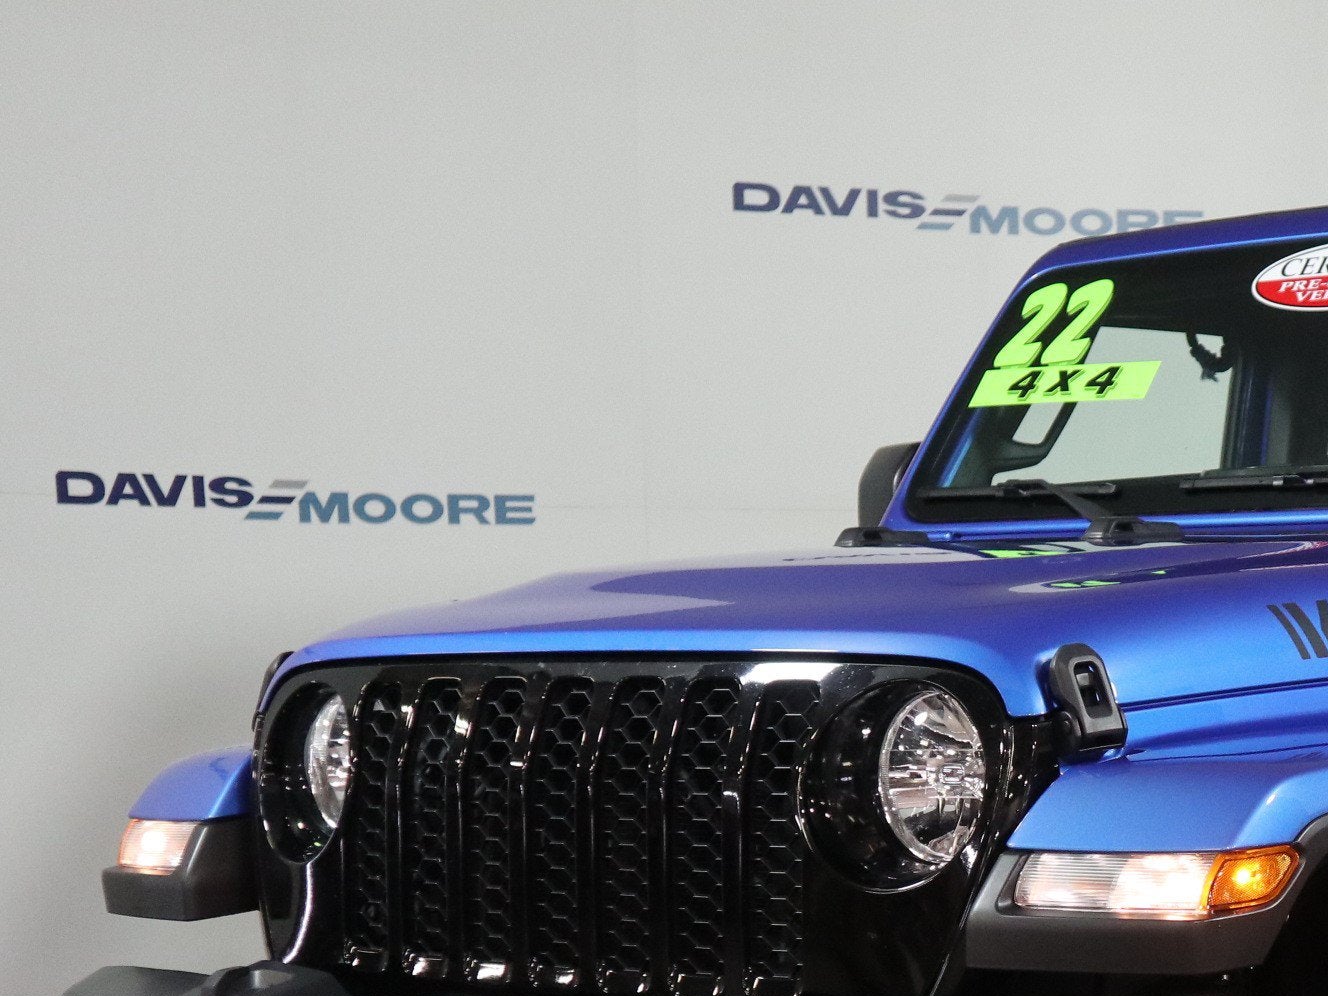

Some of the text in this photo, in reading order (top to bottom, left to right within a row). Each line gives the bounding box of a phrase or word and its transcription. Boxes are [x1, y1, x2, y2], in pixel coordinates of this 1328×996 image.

[732, 181, 927, 220] DAVIS
[993, 278, 1114, 369] 22
[55, 470, 536, 526] DAVIS MOORE
